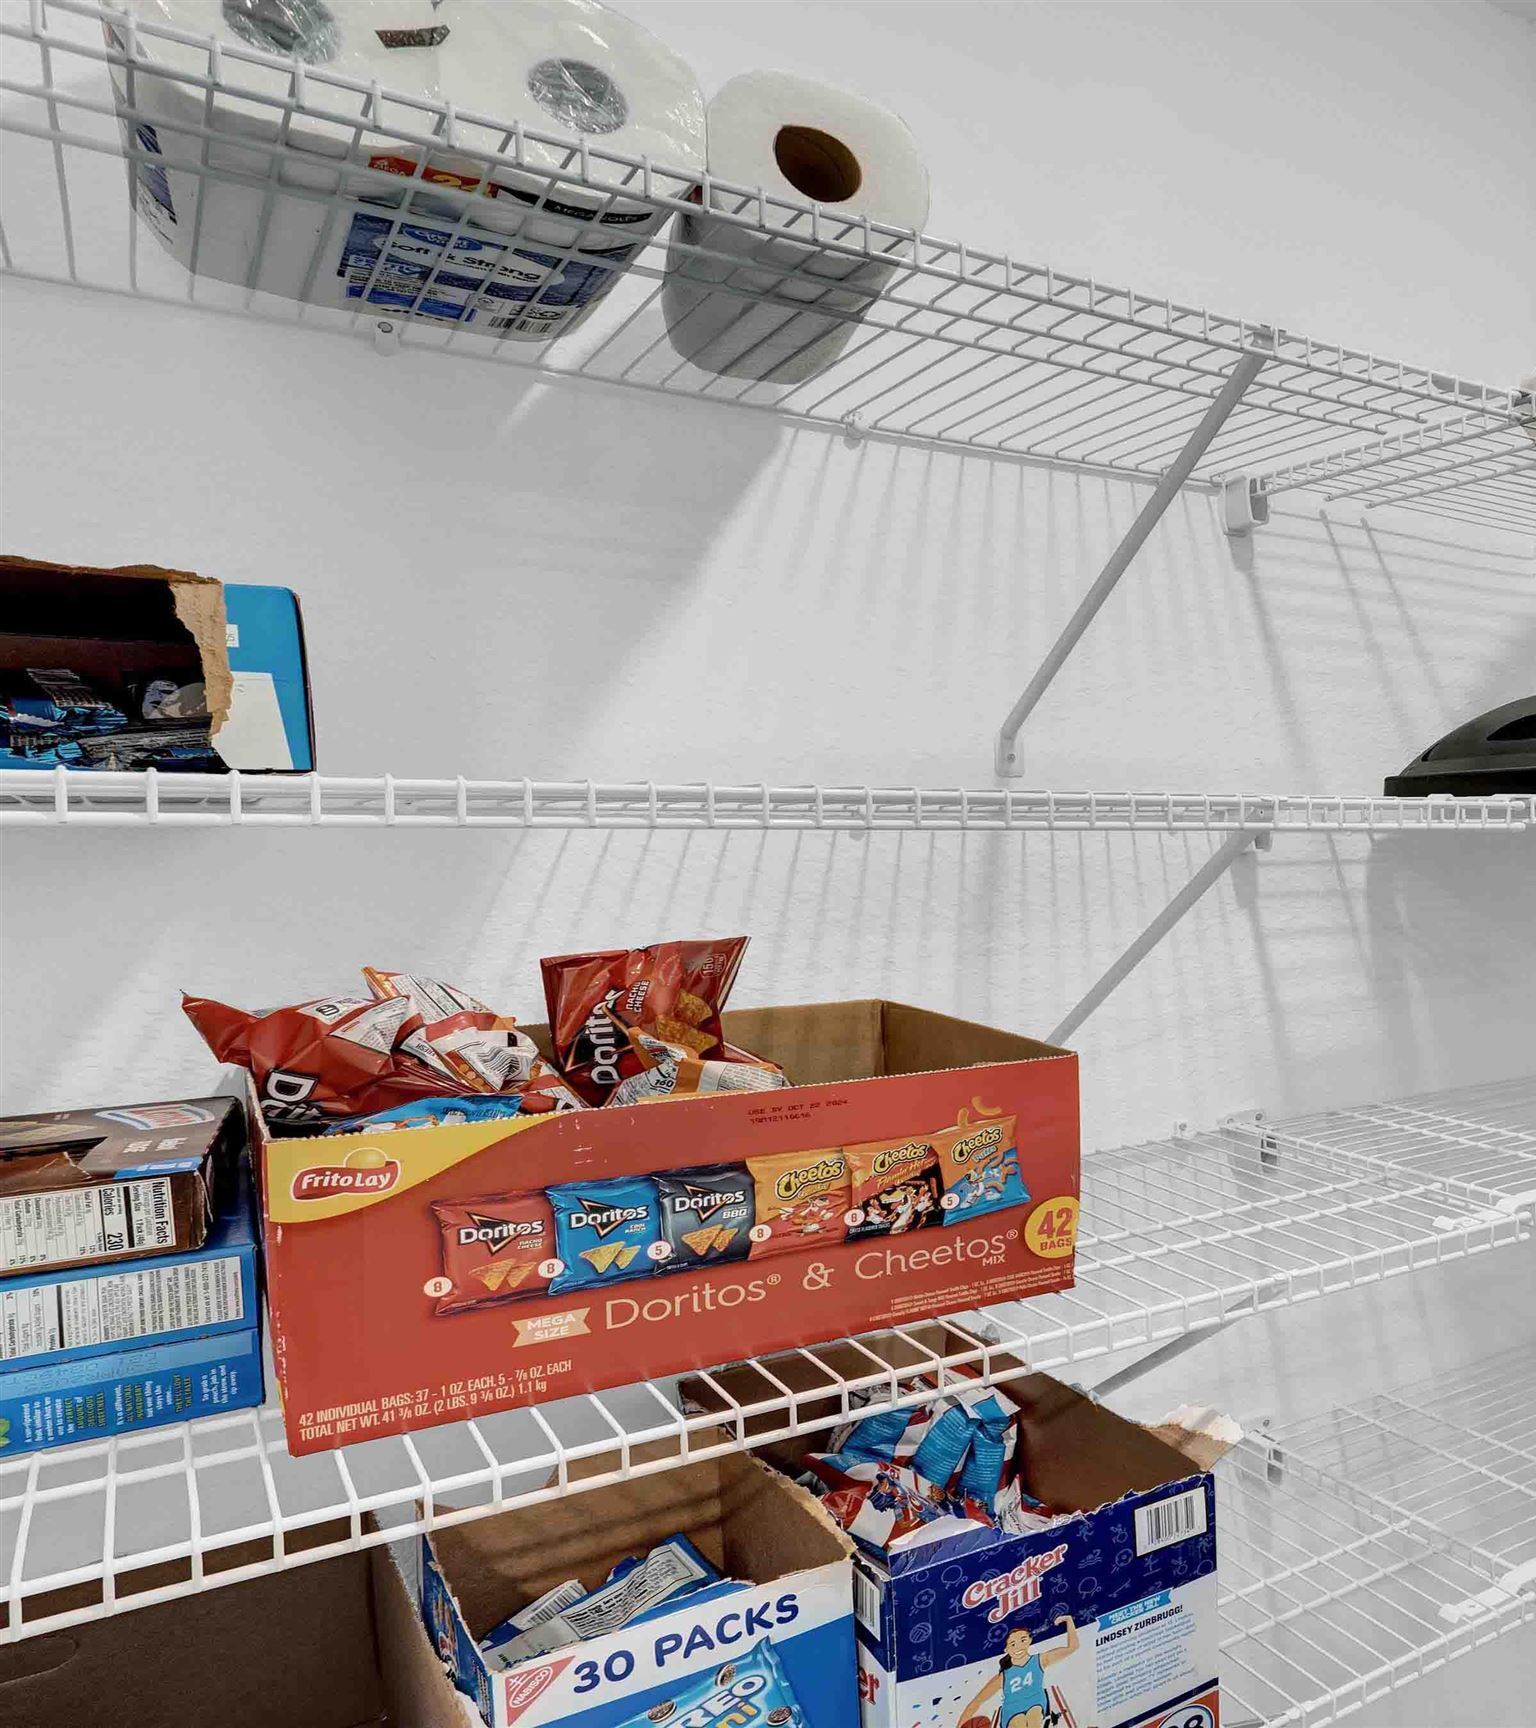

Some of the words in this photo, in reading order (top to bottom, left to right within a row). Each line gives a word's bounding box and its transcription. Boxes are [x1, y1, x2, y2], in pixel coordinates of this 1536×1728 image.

[633, 979, 650, 1014] CHEESE
[655, 1077, 676, 1090] 160
[787, 1103, 804, 1111] OCT
[952, 1127, 1002, 1164] Cheetos
[872, 1143, 928, 1175] Cheetos
[777, 1160, 844, 1200] Cheetos
[102, 1187, 116, 1217] Calories
[131, 1184, 141, 1202] Serving
[151, 1181, 167, 1220] Nutrition
[674, 1190, 746, 1213] Doritos
[134, 1202, 142, 1212] Size
[569, 1205, 650, 1230] Doritos
[136, 1222, 144, 1234] Pack
[155, 1220, 170, 1245] Facts
[458, 1219, 545, 1246] Doritos
[1037, 1207, 1073, 1239] 42
[107, 1232, 124, 1251] 230
[1040, 1239, 1073, 1251] BAGS
[982, 1252, 1006, 1267] MIX
[433, 1281, 443, 1293] 8
[802, 1262, 834, 1291] &
[526, 1312, 577, 1331] MEGA
[534, 1325, 570, 1340] SIZE
[219, 1364, 227, 1376] and
[144, 1380, 154, 1396] thing
[201, 1380, 209, 1393] grab
[298, 1413, 315, 1427] 42
[316, 1400, 379, 1425] INDIVIDUAL
[381, 1393, 415, 1410] BAGS:
[415, 1389, 430, 1403] 37
[449, 1382, 467, 1396] OZ.
[467, 1376, 497, 1393] EACH.
[498, 1373, 506, 1385] 5
[529, 1365, 546, 1380] OZ.
[546, 1360, 572, 1376] EACH
[299, 1424, 335, 1441] TOTAL
[336, 1419, 358, 1433] NET
[359, 1414, 381, 1428] WT.
[382, 1410, 395, 1424] 41
[414, 1403, 432, 1418] OZ.
[433, 1400, 445, 1416] (2
[446, 1395, 469, 1411] LBS.
[470, 1393, 478, 1405] 9
[495, 1385, 516, 1400] OZ.)
[518, 1382, 533, 1395] 1.1
[535, 1379, 548, 1394] kg
[961, 1543, 1070, 1610] Cracker
[987, 1576, 1042, 1625] Jill
[1095, 1625, 1134, 1647] LINDSEY
[1134, 1604, 1184, 1632] ZURBRUGG!
[573, 1649, 635, 1694] 30
[654, 1593, 799, 1668] PACKS
[512, 1668, 551, 1705] NABISCO
[1009, 1671, 1034, 1693] 24
[674, 1674, 767, 1728] REO
